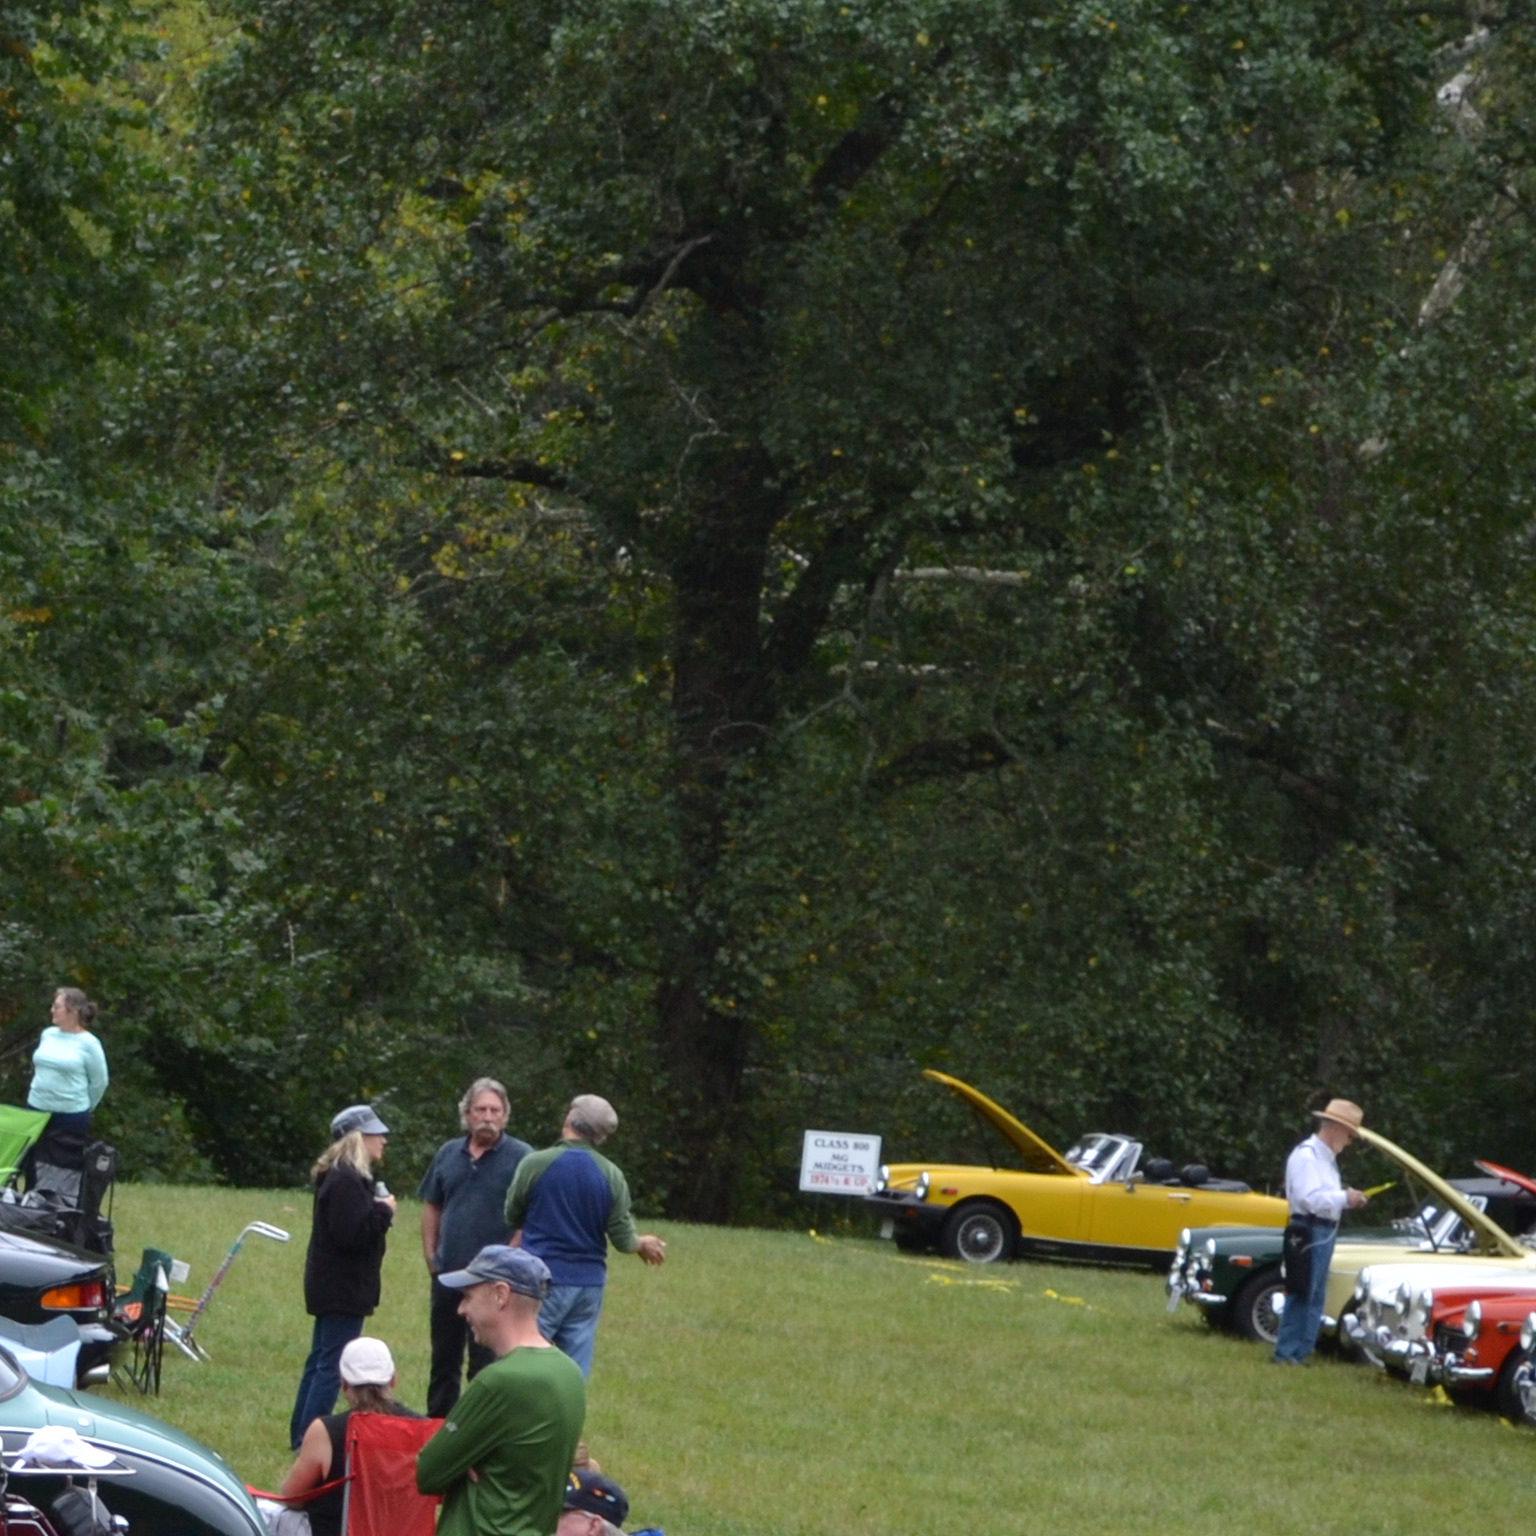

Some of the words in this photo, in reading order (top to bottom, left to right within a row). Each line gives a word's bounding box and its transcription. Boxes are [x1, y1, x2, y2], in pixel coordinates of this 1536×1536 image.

[814, 1138, 849, 1149] CLASS
[831, 1153, 849, 1162] MG
[813, 1162, 864, 1173] MIDGETS
